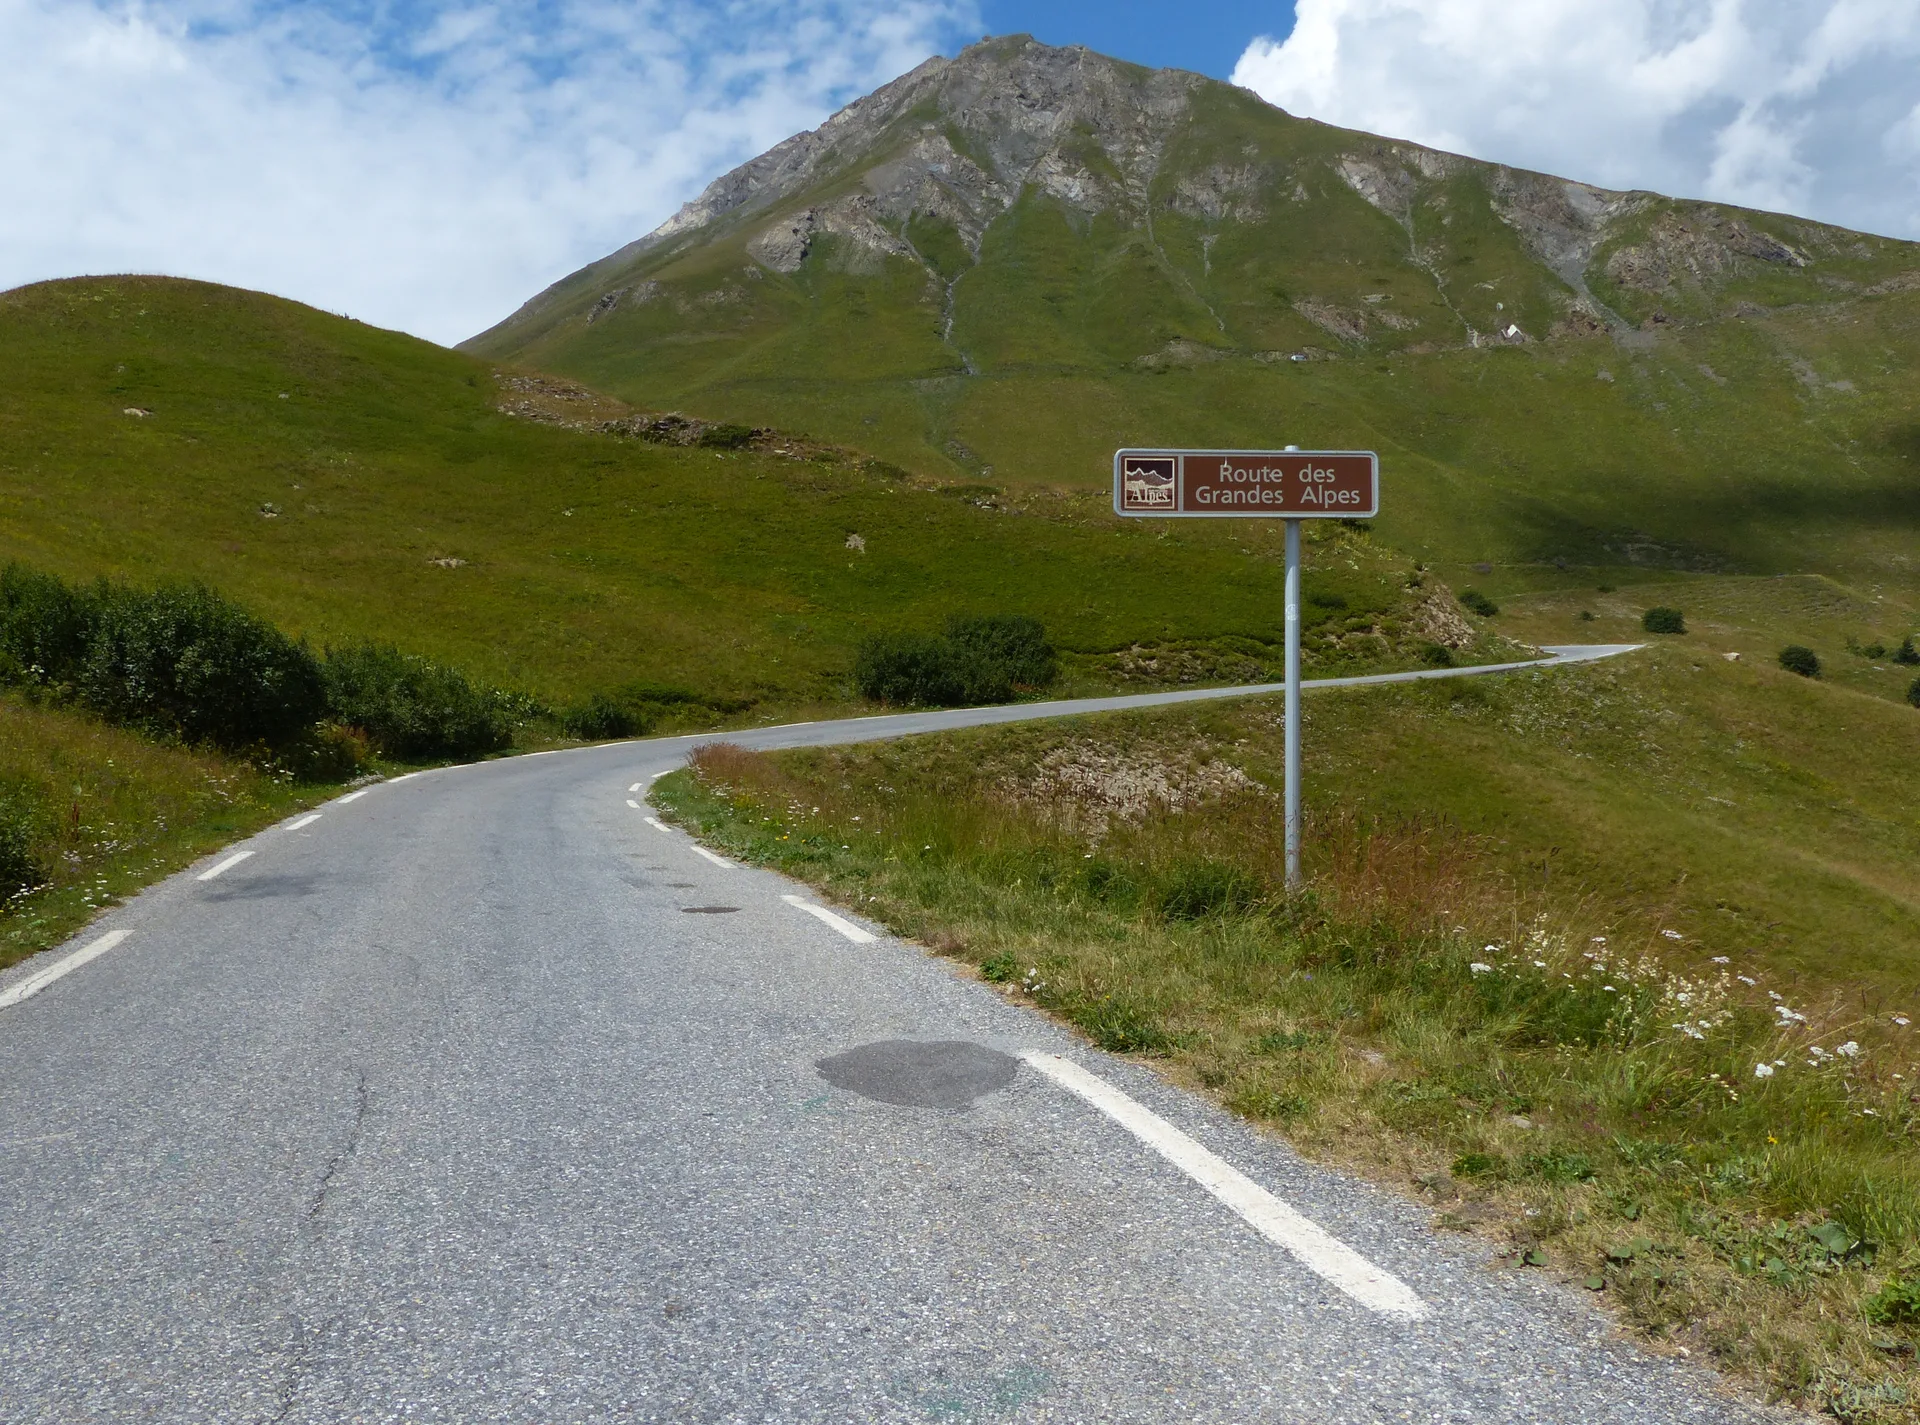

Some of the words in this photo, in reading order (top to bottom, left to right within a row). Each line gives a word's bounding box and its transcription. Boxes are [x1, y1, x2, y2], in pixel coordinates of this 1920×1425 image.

[1219, 464, 1283, 483] Route
[1298, 463, 1336, 483] des
[1130, 488, 1169, 505] Alpes
[1195, 485, 1284, 504] Grandes
[1300, 485, 1361, 509] Alpes
